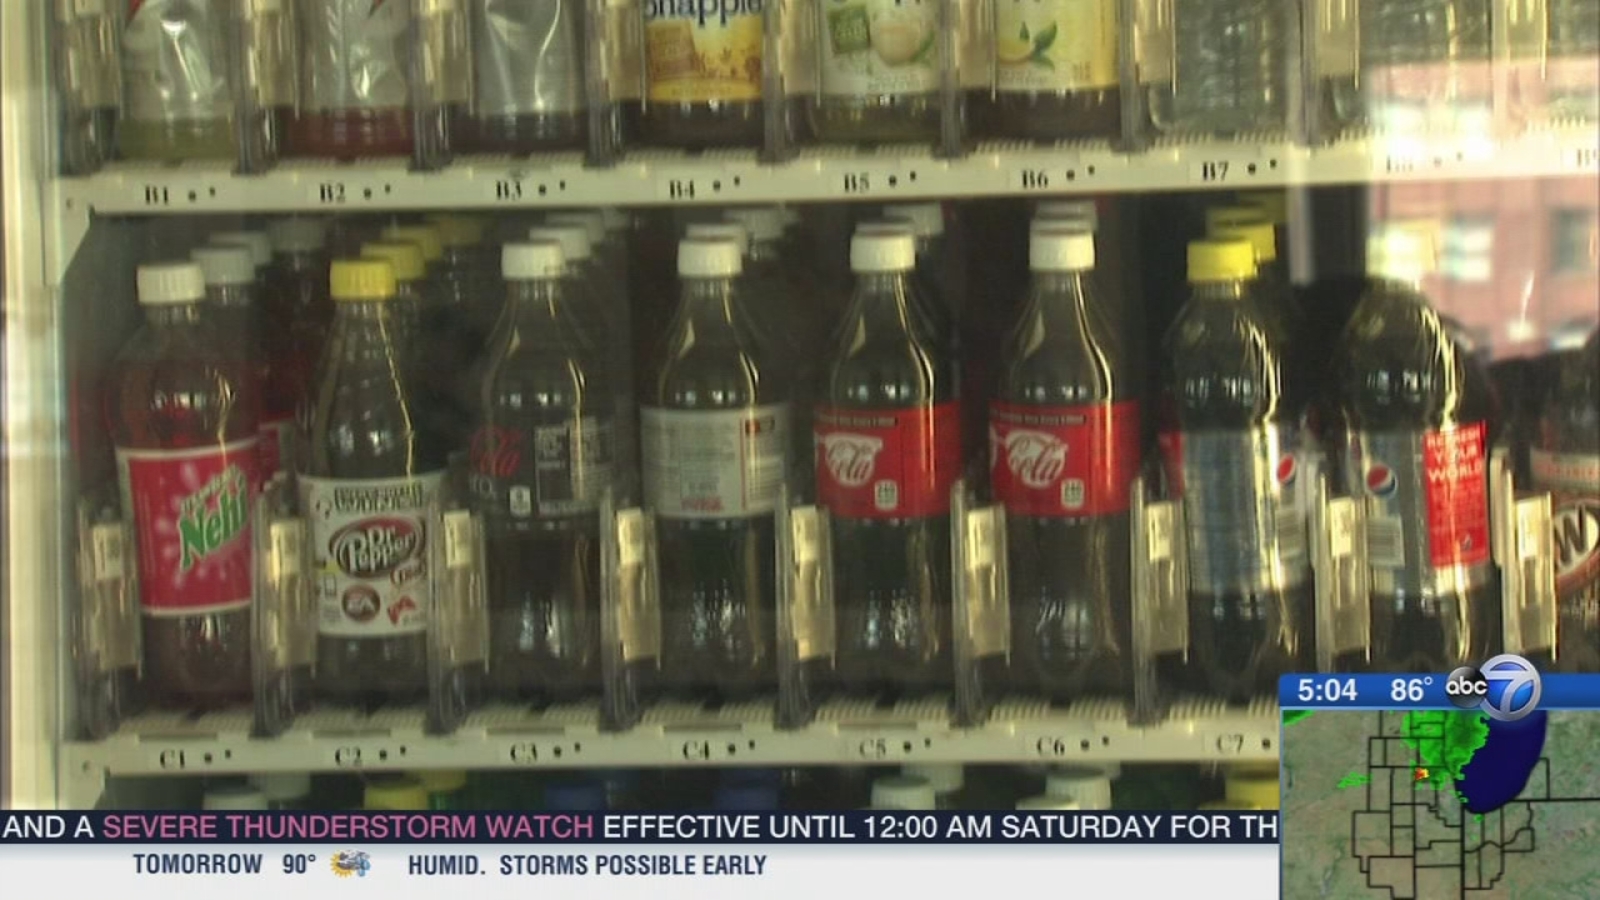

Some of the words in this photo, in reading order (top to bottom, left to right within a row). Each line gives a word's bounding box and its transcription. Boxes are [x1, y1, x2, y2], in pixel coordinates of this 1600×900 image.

[1021, 169, 1049, 189] B6
[1202, 161, 1229, 180] B7
[319, 183, 346, 203] B2
[496, 180, 522, 200] B3
[669, 179, 695, 199] B4
[843, 173, 870, 193] B5
[145, 184, 169, 204] B1
[176, 474, 249, 572] Nehi
[366, 526, 397, 550] Dr
[348, 530, 415, 573] Pepper
[510, 743, 538, 763] C3
[683, 740, 710, 760] C4
[859, 738, 888, 758] C5
[1036, 736, 1066, 756] C6
[1215, 733, 1245, 753] C7
[159, 749, 186, 769] C1
[334, 747, 363, 767] C2
